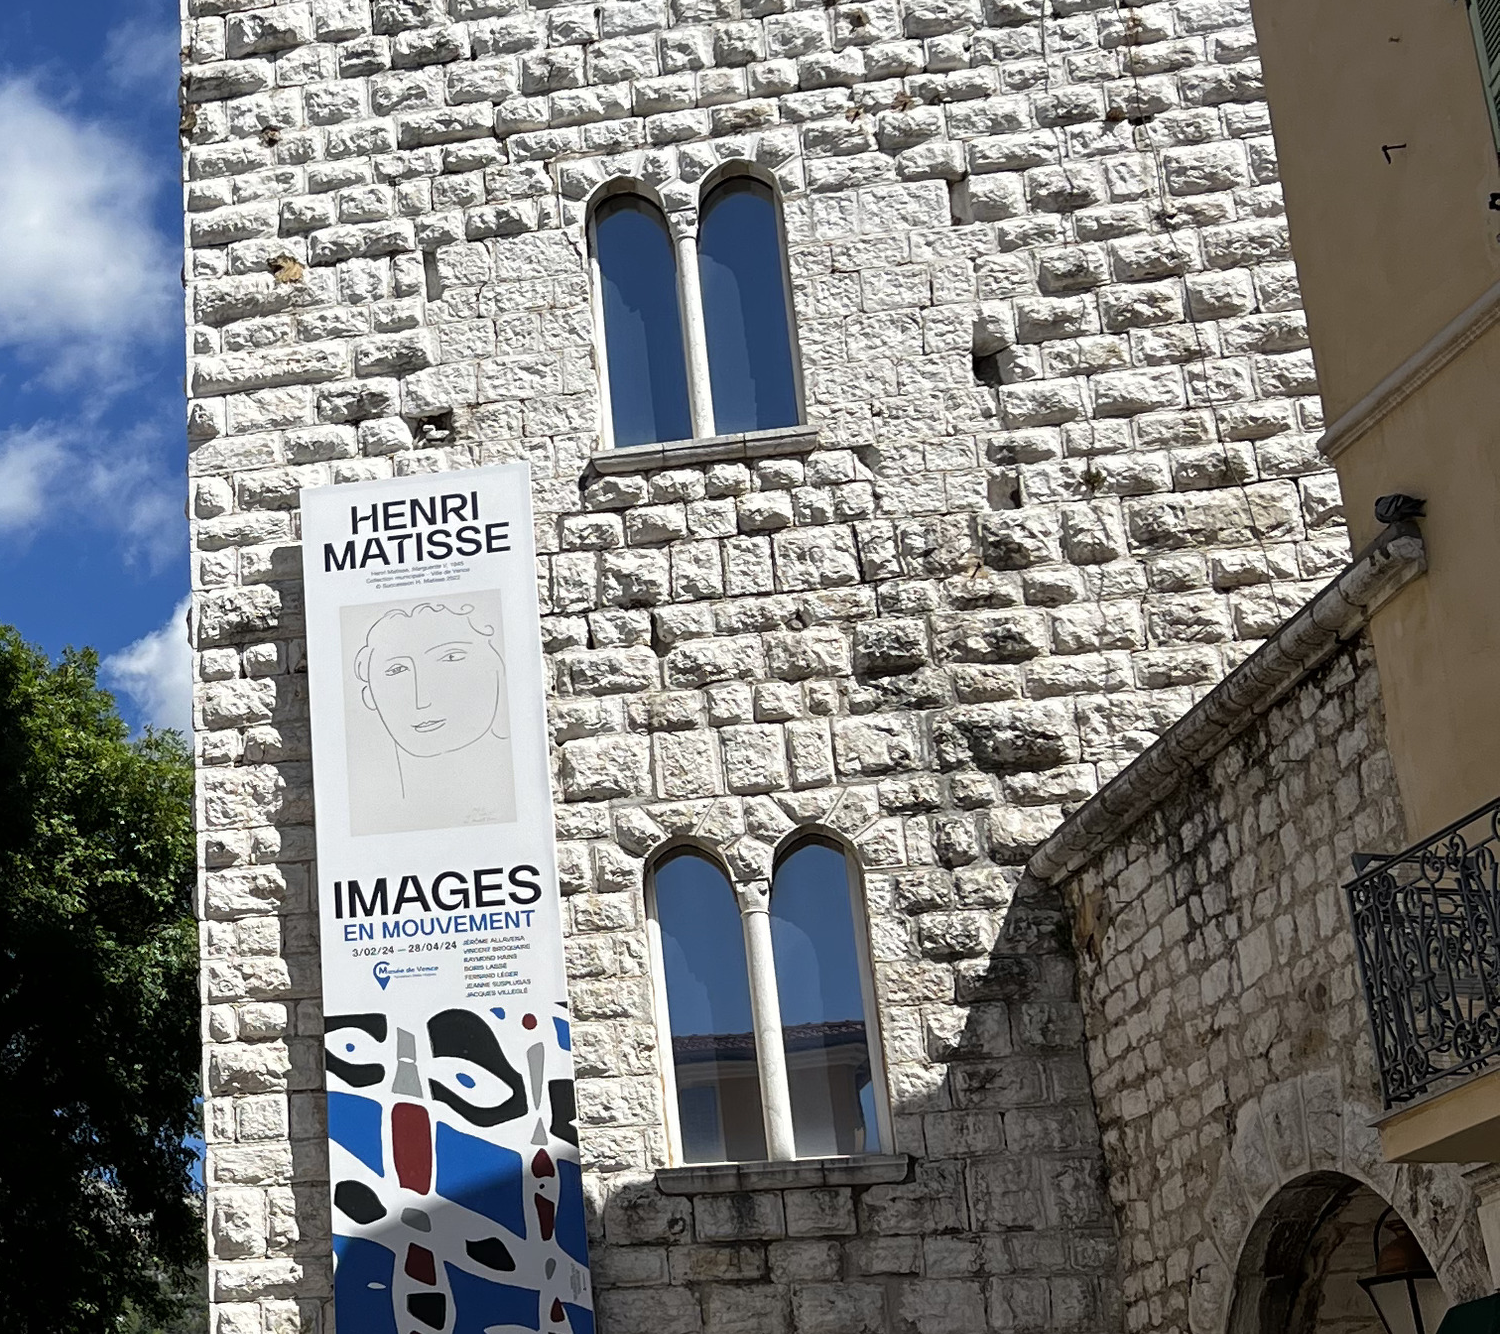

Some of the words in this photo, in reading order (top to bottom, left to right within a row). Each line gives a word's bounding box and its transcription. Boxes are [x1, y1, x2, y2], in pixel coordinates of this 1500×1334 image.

[351, 491, 479, 535] HENRI
[323, 522, 511, 572] MATISSE
[333, 864, 542, 919] IMAGES
[343, 922, 374, 942] EN
[382, 909, 536, 939] MOUVEMENT
[352, 946, 395, 957] 3/02/24
[408, 941, 457, 953] 28/04/24
[463, 947, 491, 955] VINCENT
[464, 955, 496, 963] RAYMOND
